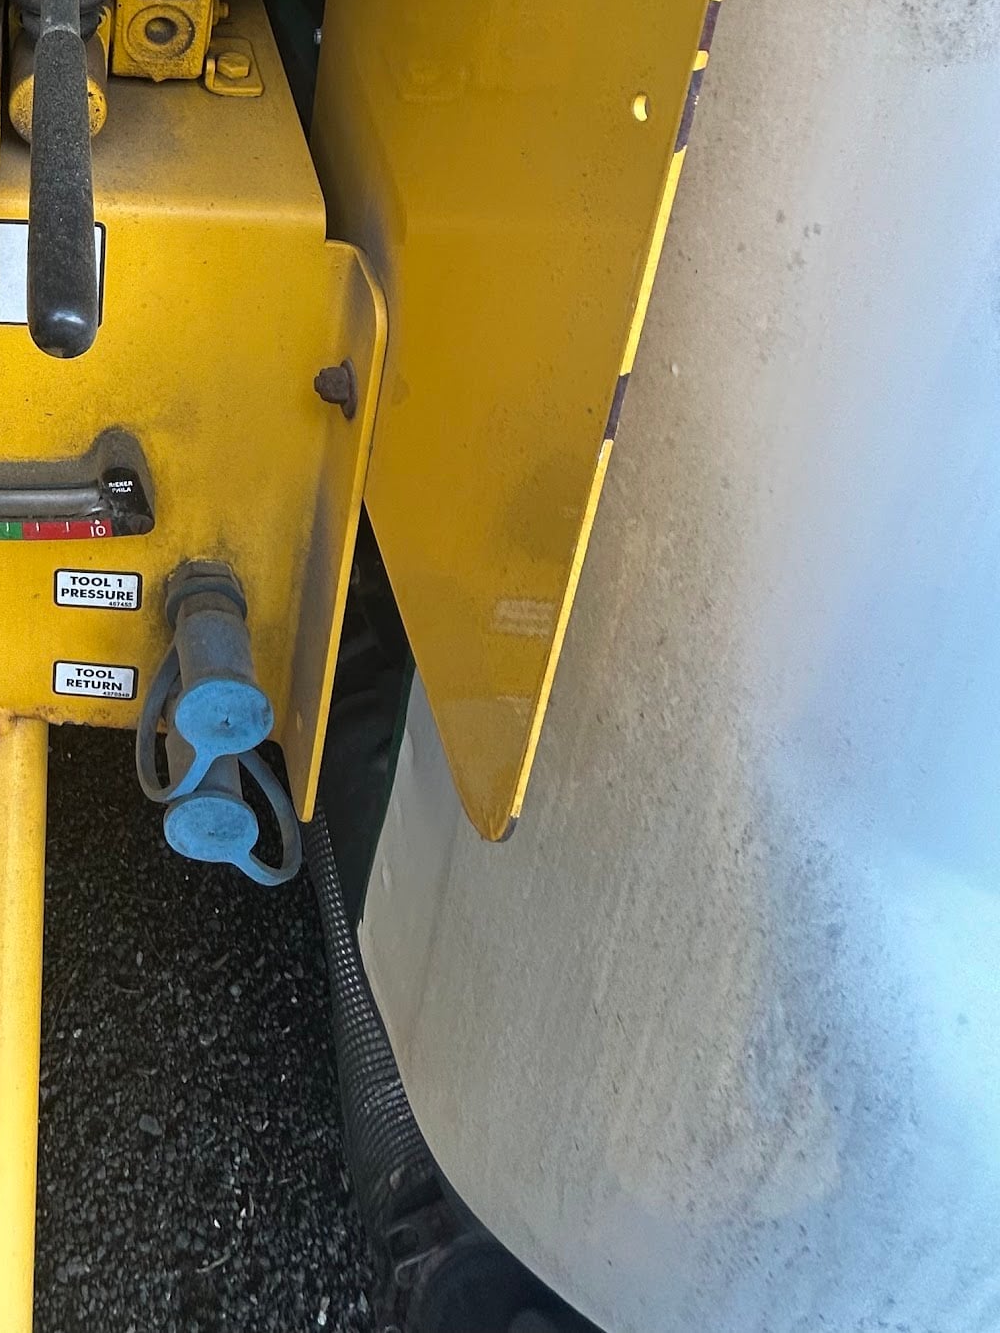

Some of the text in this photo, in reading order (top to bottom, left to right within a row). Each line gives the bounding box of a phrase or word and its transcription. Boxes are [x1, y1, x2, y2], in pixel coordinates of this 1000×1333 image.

[90, 525, 106, 537] 10
[70, 576, 123, 588] TOOL 1
[61, 588, 134, 601] PRESSURE
[75, 668, 115, 679] TOOL
[66, 678, 123, 691] RETURN
